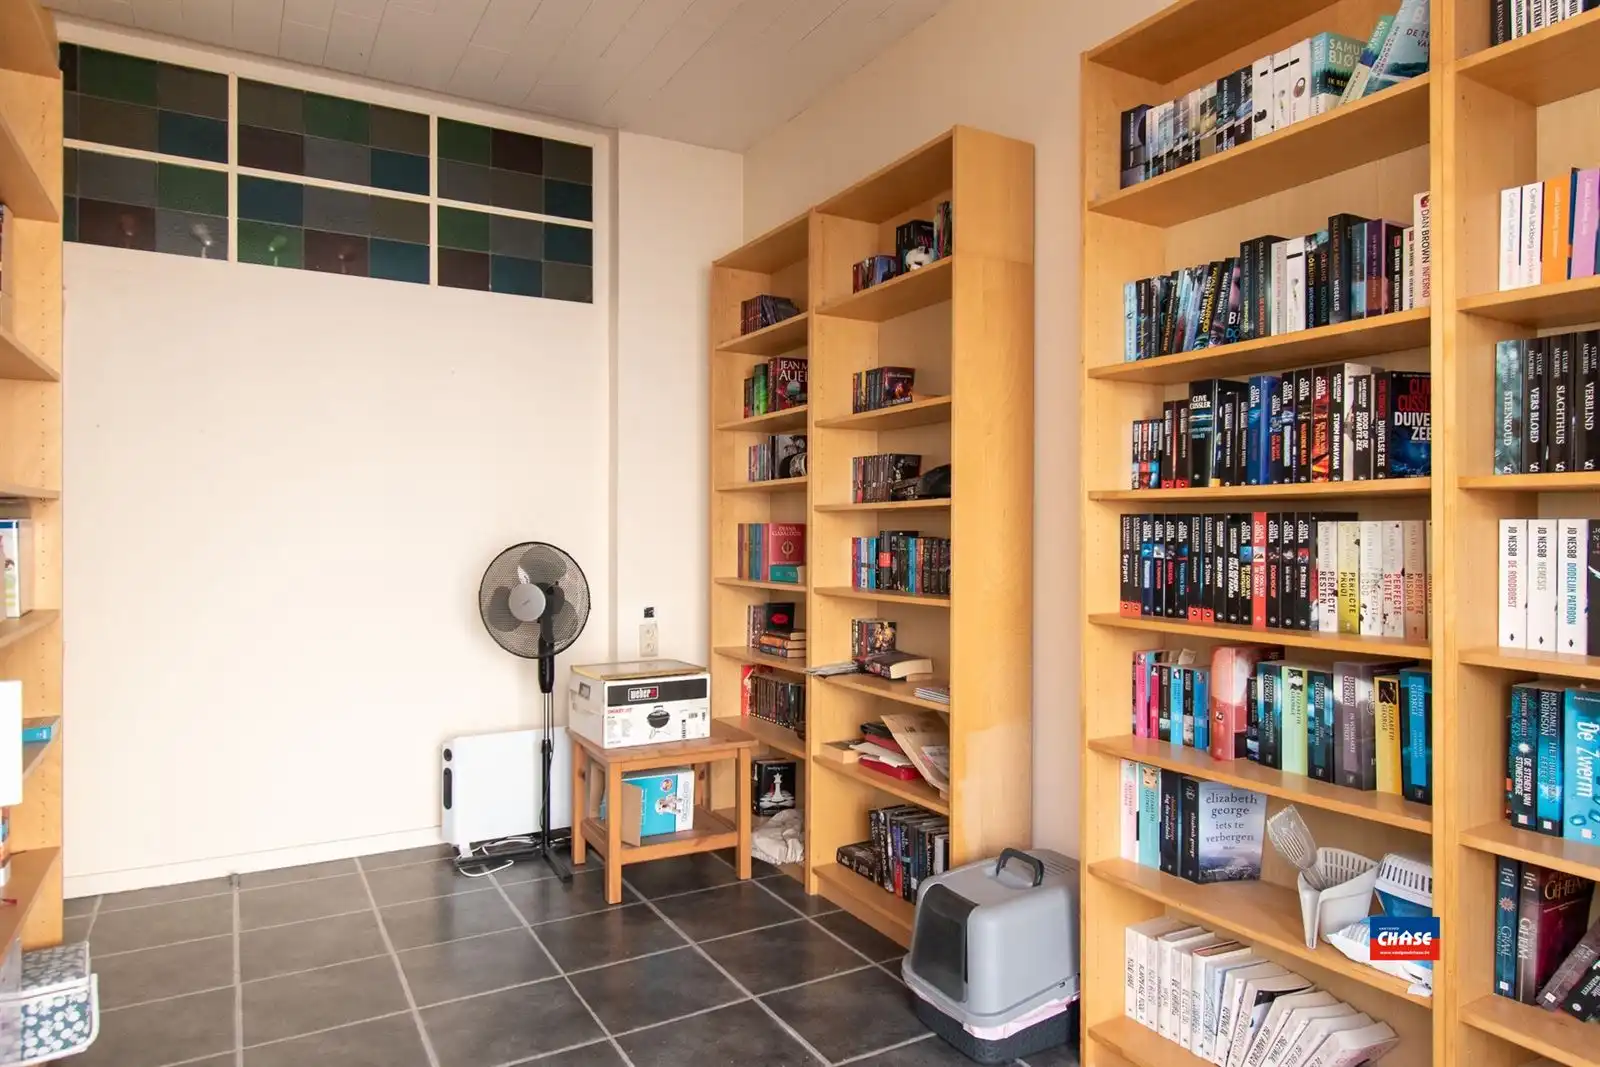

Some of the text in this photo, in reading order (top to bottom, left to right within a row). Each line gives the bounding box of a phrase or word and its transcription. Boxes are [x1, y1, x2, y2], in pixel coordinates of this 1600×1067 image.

[1406, 28, 1417, 37] DE
[1421, 210, 1430, 298] DAN BROWN INFERNO
[780, 360, 800, 370] JEAN
[1582, 343, 1590, 375] MACBRIDE
[1193, 395, 1207, 403] CLIVE
[1530, 387, 1540, 443] VERS BLOED
[1556, 385, 1566, 445] SLACHTHUIS
[1584, 382, 1594, 430] VERBLIND
[1378, 420, 1386, 451] DUIVELSE
[1394, 412, 1430, 426] DUIVE
[1503, 391, 1513, 447] STEENKOUD
[1122, 554, 1130, 583] Serpent
[1508, 526, 1517, 608] JO NESBØ DE ROODBORST
[1538, 526, 1547, 591] JO NESBØ NEMESIS
[1566, 527, 1577, 626] JO NESBØ DODELIJK PATROON
[1320, 571, 1328, 604] RESTEN
[1328, 571, 1336, 614] PERFECTE
[1340, 572, 1348, 597] PROOI
[1348, 572, 1356, 614] PERFECTE
[1384, 574, 1392, 602] STILTE
[1394, 574, 1402, 616] PERFECTE
[1406, 573, 1414, 612] MISDAAD
[1415, 573, 1424, 616] PERFECTE
[630, 688, 651, 700] weber
[1410, 684, 1418, 716] GEORGE
[1540, 692, 1550, 736] ROBINSON
[1549, 706, 1557, 738] STANLEY
[1515, 756, 1523, 796] STONEHENGE
[1576, 720, 1600, 799] De Zwerm
[1206, 791, 1257, 804] elizabeth
[1522, 758, 1532, 806] DE STENEN VAN
[1211, 806, 1250, 820] george
[1216, 821, 1244, 830] iets te
[1206, 832, 1254, 844] verbergen
